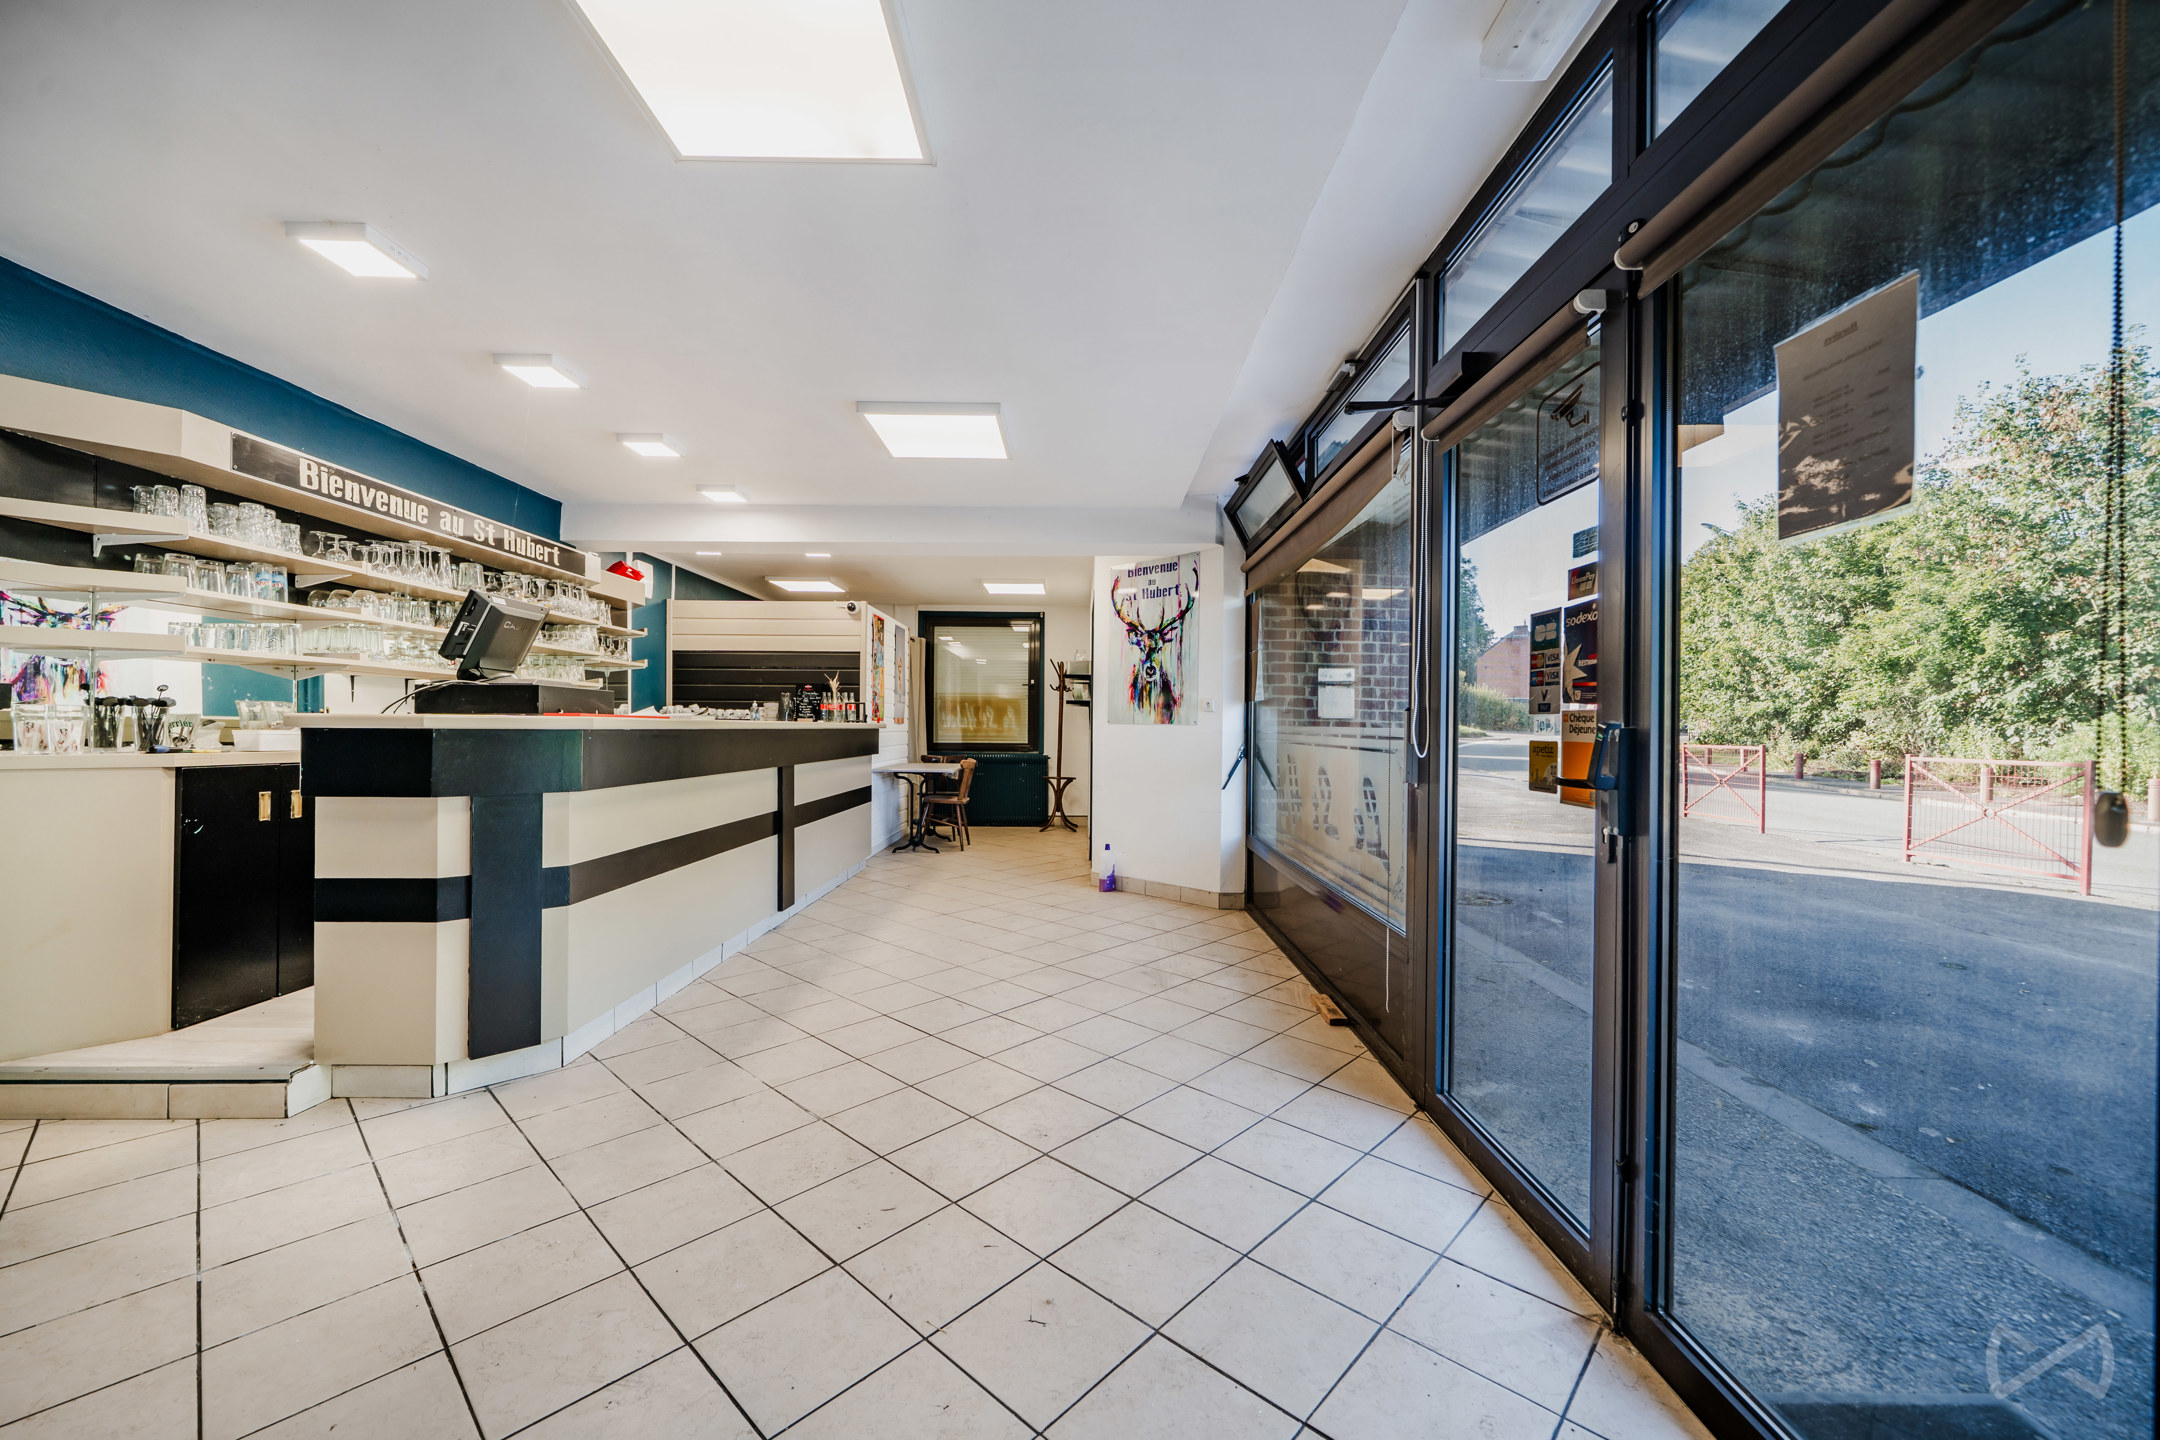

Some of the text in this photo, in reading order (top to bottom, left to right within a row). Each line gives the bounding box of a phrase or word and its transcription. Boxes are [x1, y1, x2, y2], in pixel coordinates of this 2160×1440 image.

[299, 457, 560, 567] Bienvenue au St Hubert
[1127, 561, 1178, 578] Bienvenue
[1141, 584, 1180, 600] Hubert
[1565, 611, 1599, 627] sodexo
[1546, 653, 1560, 662] VISA
[1546, 671, 1560, 680] VISA
[1569, 713, 1595, 724] Chèque
[1568, 724, 1596, 736] Déjeune
